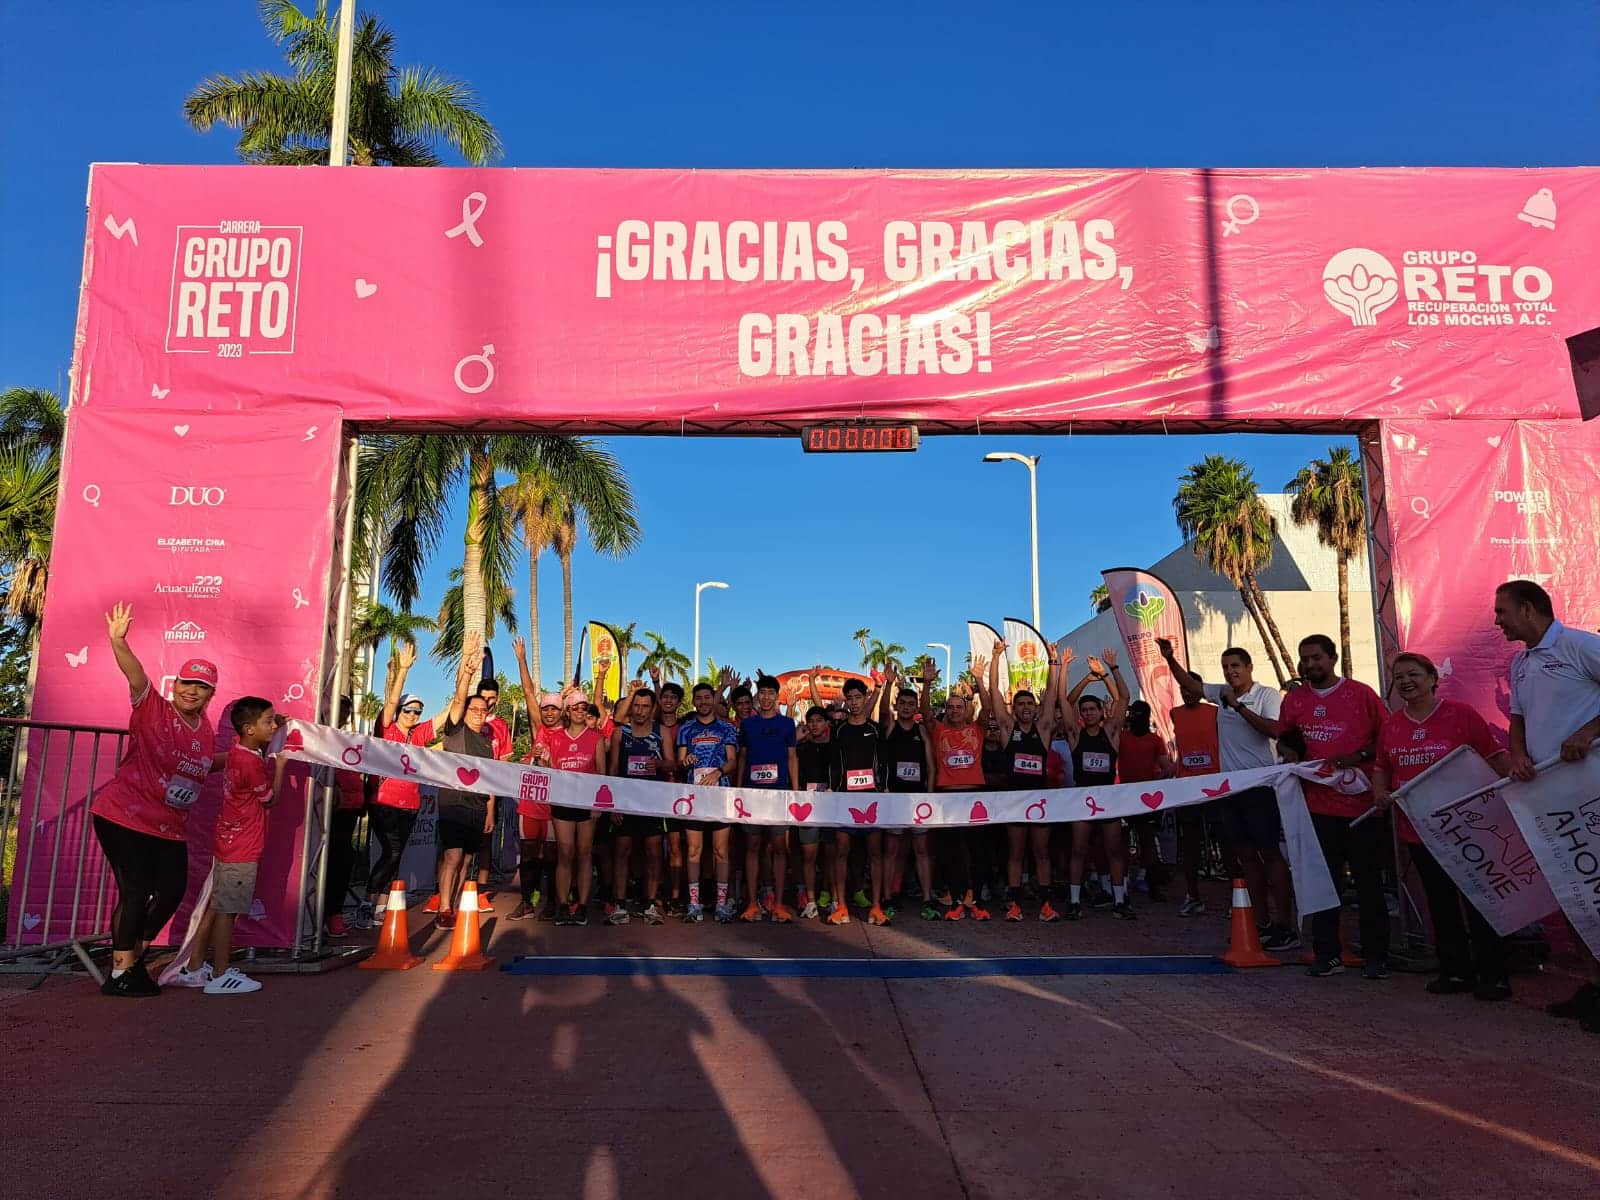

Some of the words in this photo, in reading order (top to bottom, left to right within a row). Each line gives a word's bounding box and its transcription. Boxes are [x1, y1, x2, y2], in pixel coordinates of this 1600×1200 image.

[220, 220, 261, 234] CARRERA
[183, 237, 292, 279] GRUPO
[595, 219, 865, 298] ¡GRACIAS,
[883, 219, 1134, 290] GRACIAS,
[1402, 250, 1477, 265] GRUPO
[1402, 264, 1553, 303] RETO
[175, 280, 290, 339] RETO
[1513, 302, 1557, 313] TOTAL
[1407, 313, 1439, 326] LOS
[1444, 313, 1514, 326] MOCHIS
[1519, 313, 1552, 326] A.C.
[217, 343, 243, 358] 2023
[737, 311, 992, 377] GRACIAS!
[169, 486, 225, 506] DUO
[157, 538, 203, 546] ELIZABETH
[153, 582, 221, 593] Acuacultores
[522, 773, 549, 786] GRUPO
[520, 785, 548, 800] RETO
[1430, 808, 1520, 900] AHOME
[1547, 811, 1600, 917] AHOM
